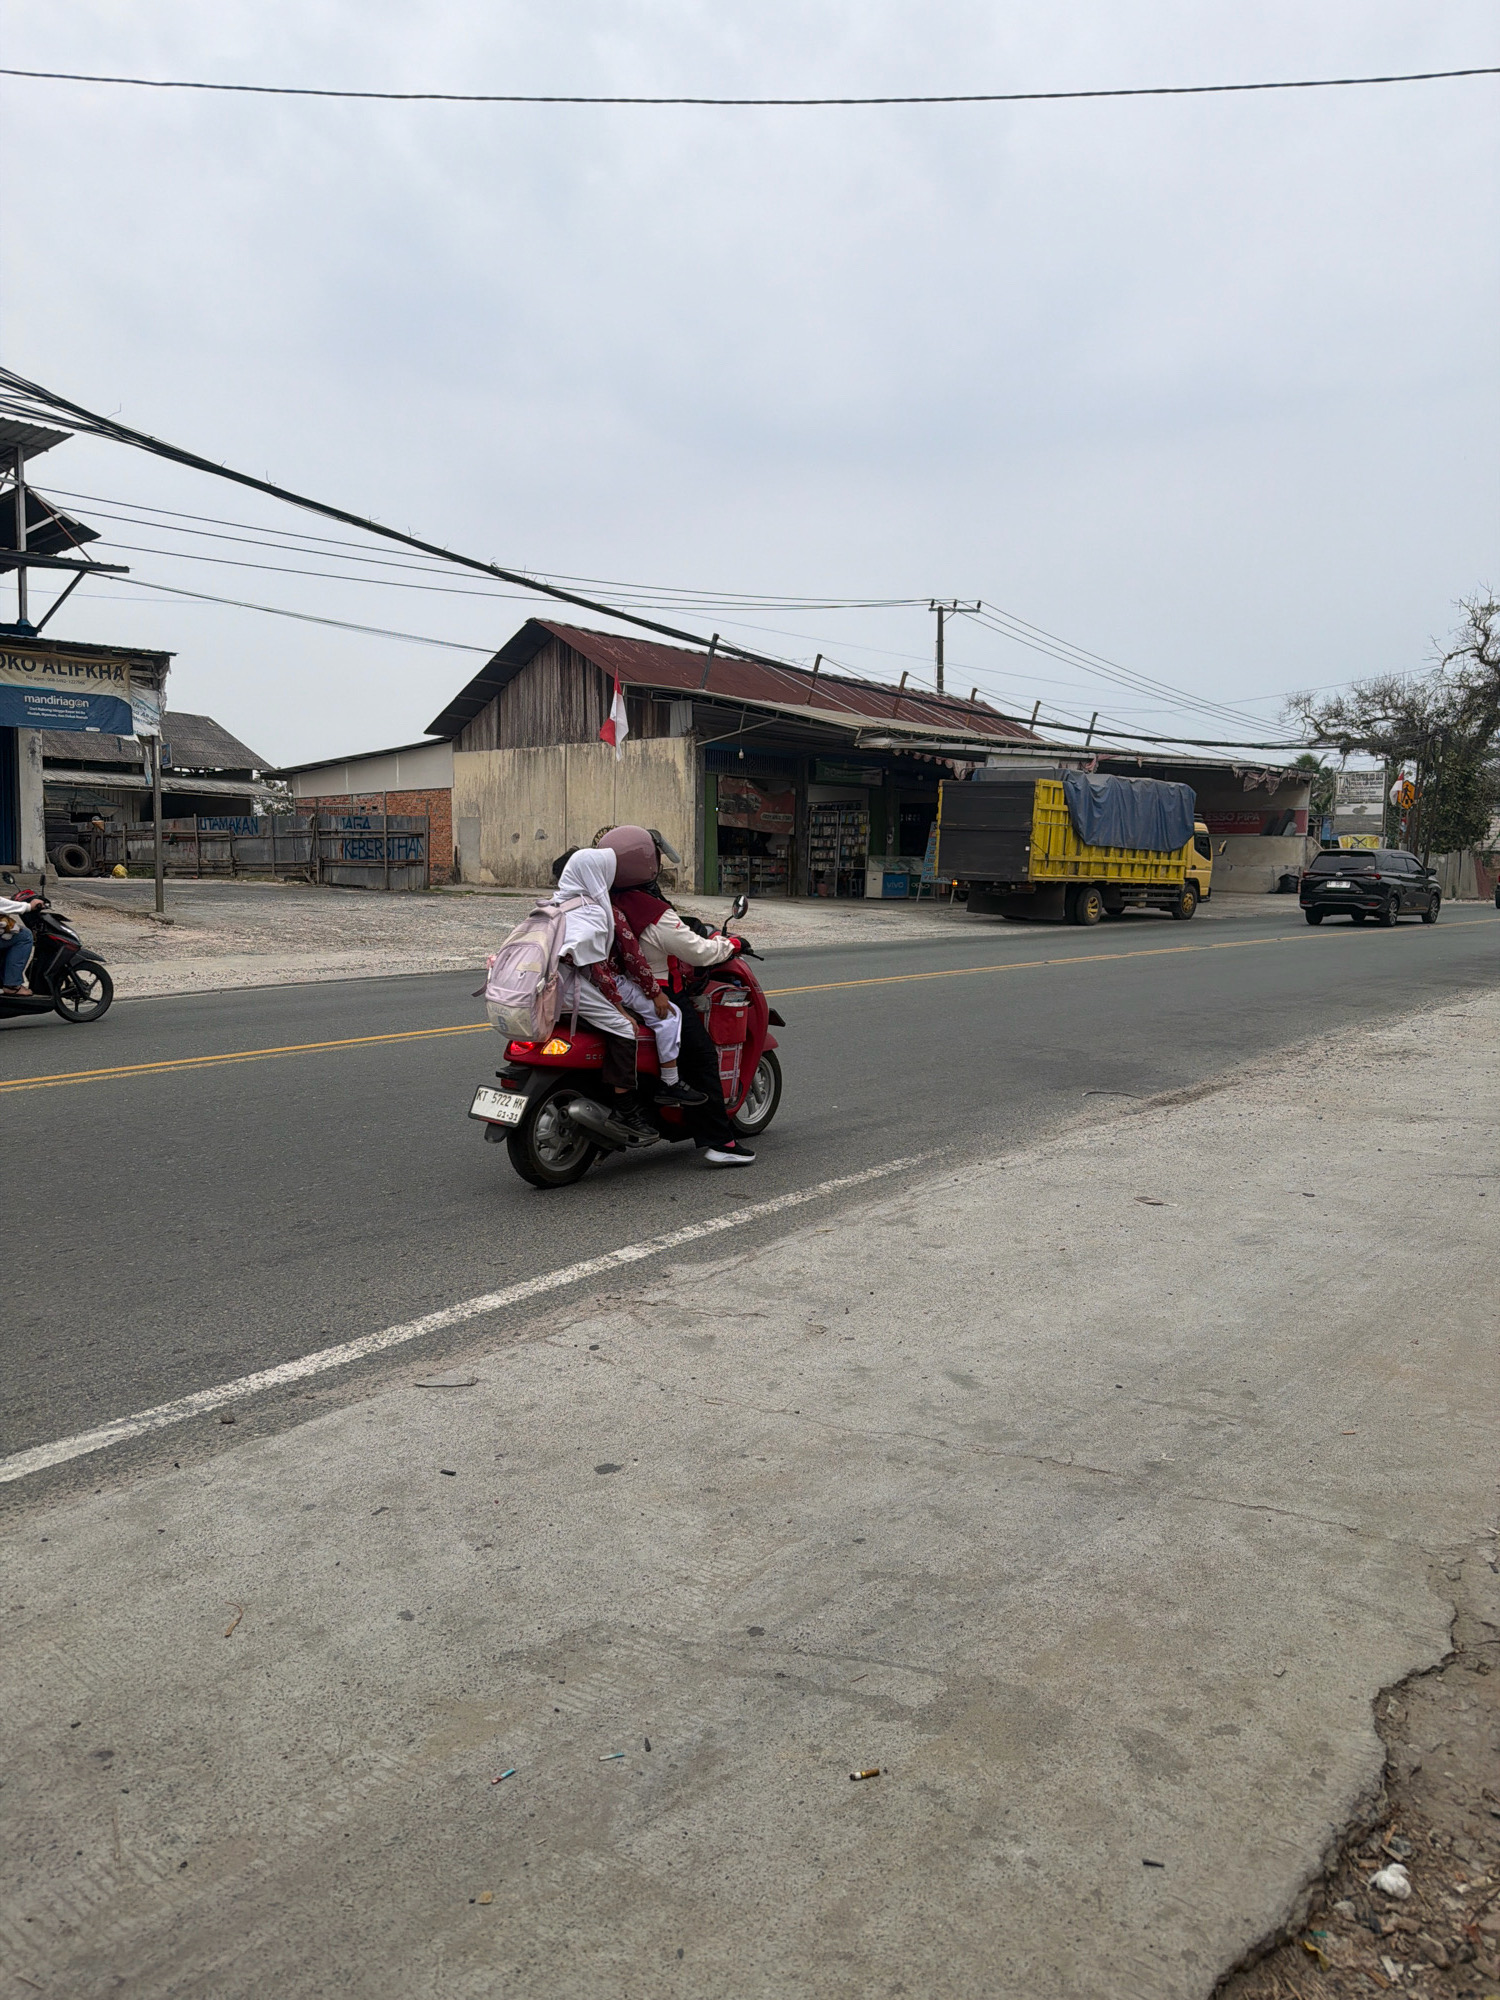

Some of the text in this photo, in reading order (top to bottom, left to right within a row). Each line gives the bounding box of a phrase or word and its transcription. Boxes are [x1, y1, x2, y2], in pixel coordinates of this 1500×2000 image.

[42, 660, 125, 680] ALIFKHA
[200, 816, 259, 836] UTAMAKAN
[342, 816, 372, 831] JAGA
[476, 1089, 489, 1102] KT
[491, 1092, 512, 1107] 5722
